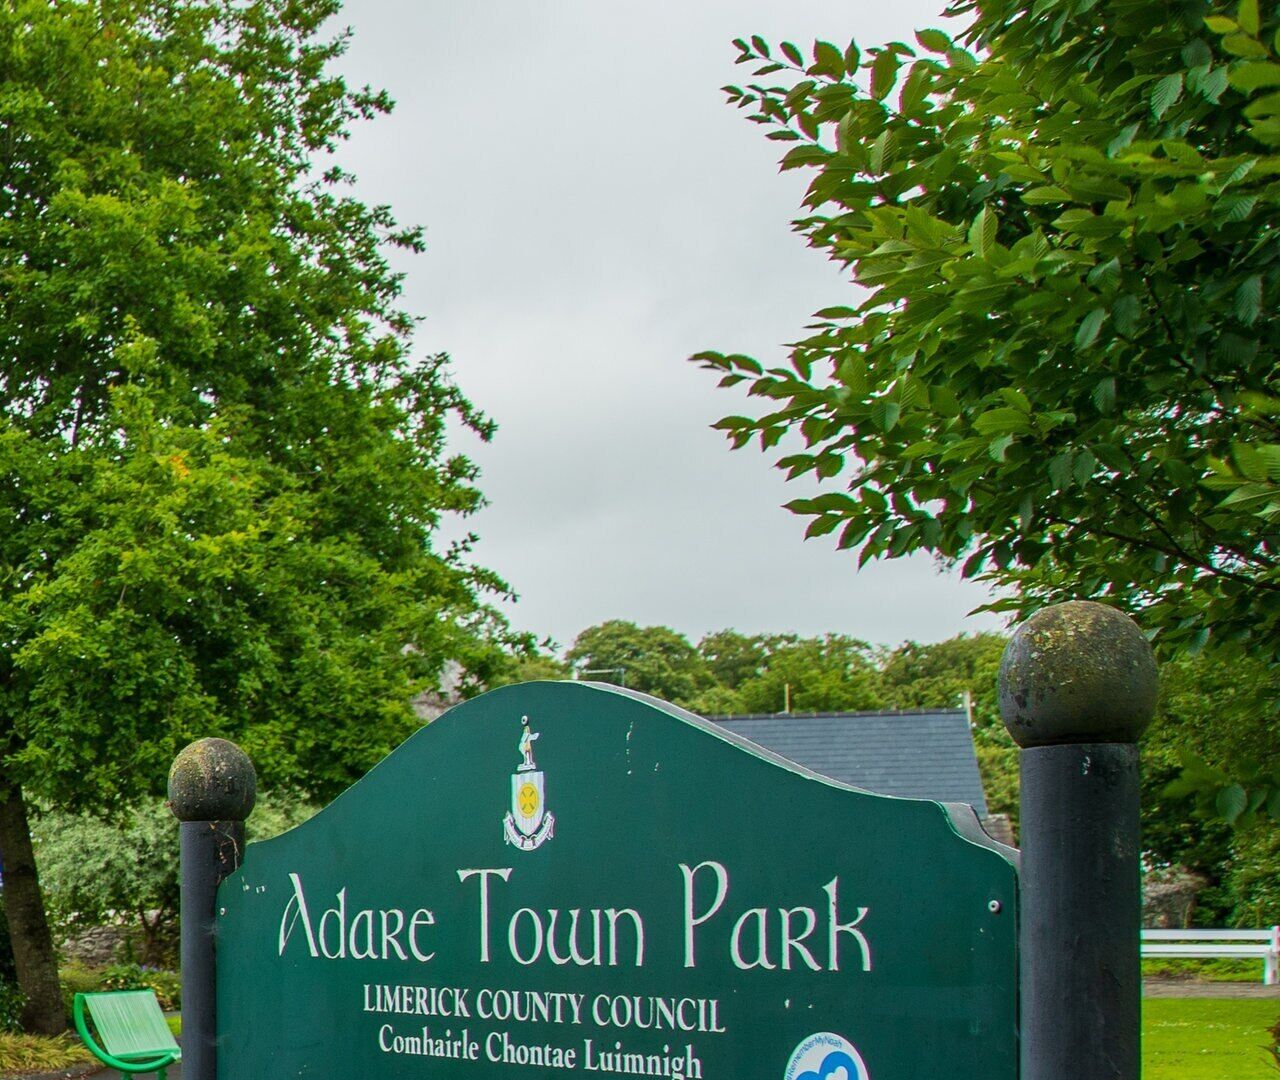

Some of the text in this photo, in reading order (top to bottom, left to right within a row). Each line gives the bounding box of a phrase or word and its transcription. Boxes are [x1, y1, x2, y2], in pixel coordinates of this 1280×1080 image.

[278, 860, 872, 972] Adare Town Park
[363, 984, 726, 1033] LIMERICK COUNTY COUNCIL
[379, 1024, 480, 1061] Comhairle
[485, 1031, 577, 1069] Chontae
